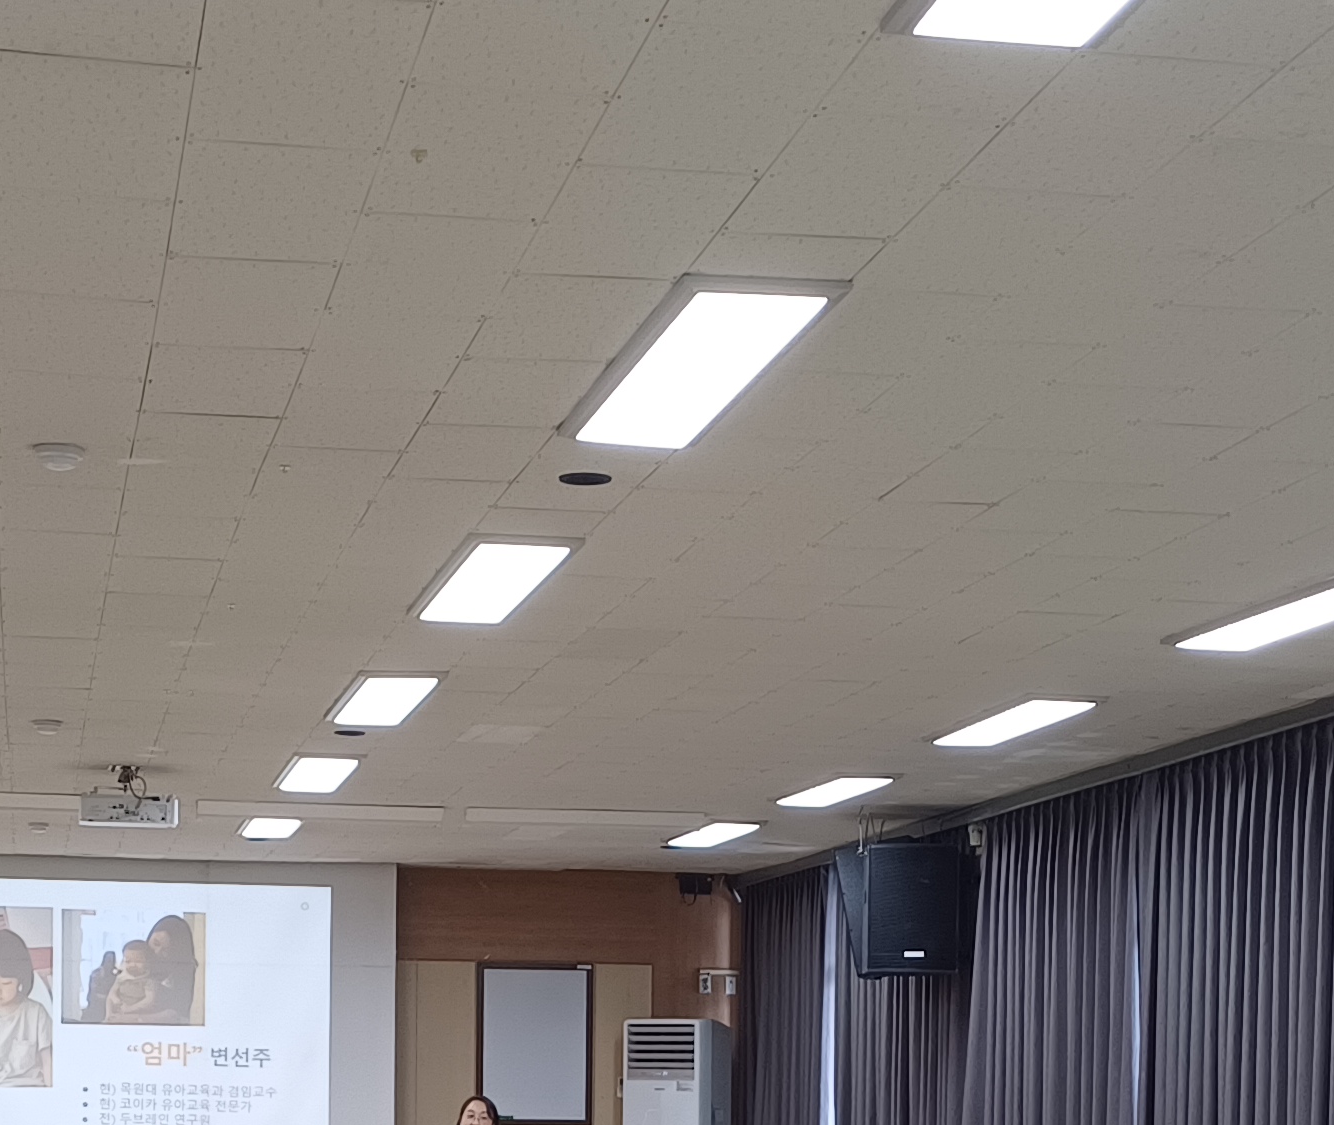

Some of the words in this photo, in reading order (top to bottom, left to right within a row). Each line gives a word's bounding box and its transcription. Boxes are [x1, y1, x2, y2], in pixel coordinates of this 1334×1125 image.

[210, 1046, 272, 1068] 변선주
[120, 1082, 157, 1097] 목원대
[161, 1083, 224, 1098] 유아교육과
[120, 1097, 157, 1111] 코이카
[161, 1098, 210, 1113] 유아교육
[215, 1099, 252, 1114] 전문가
